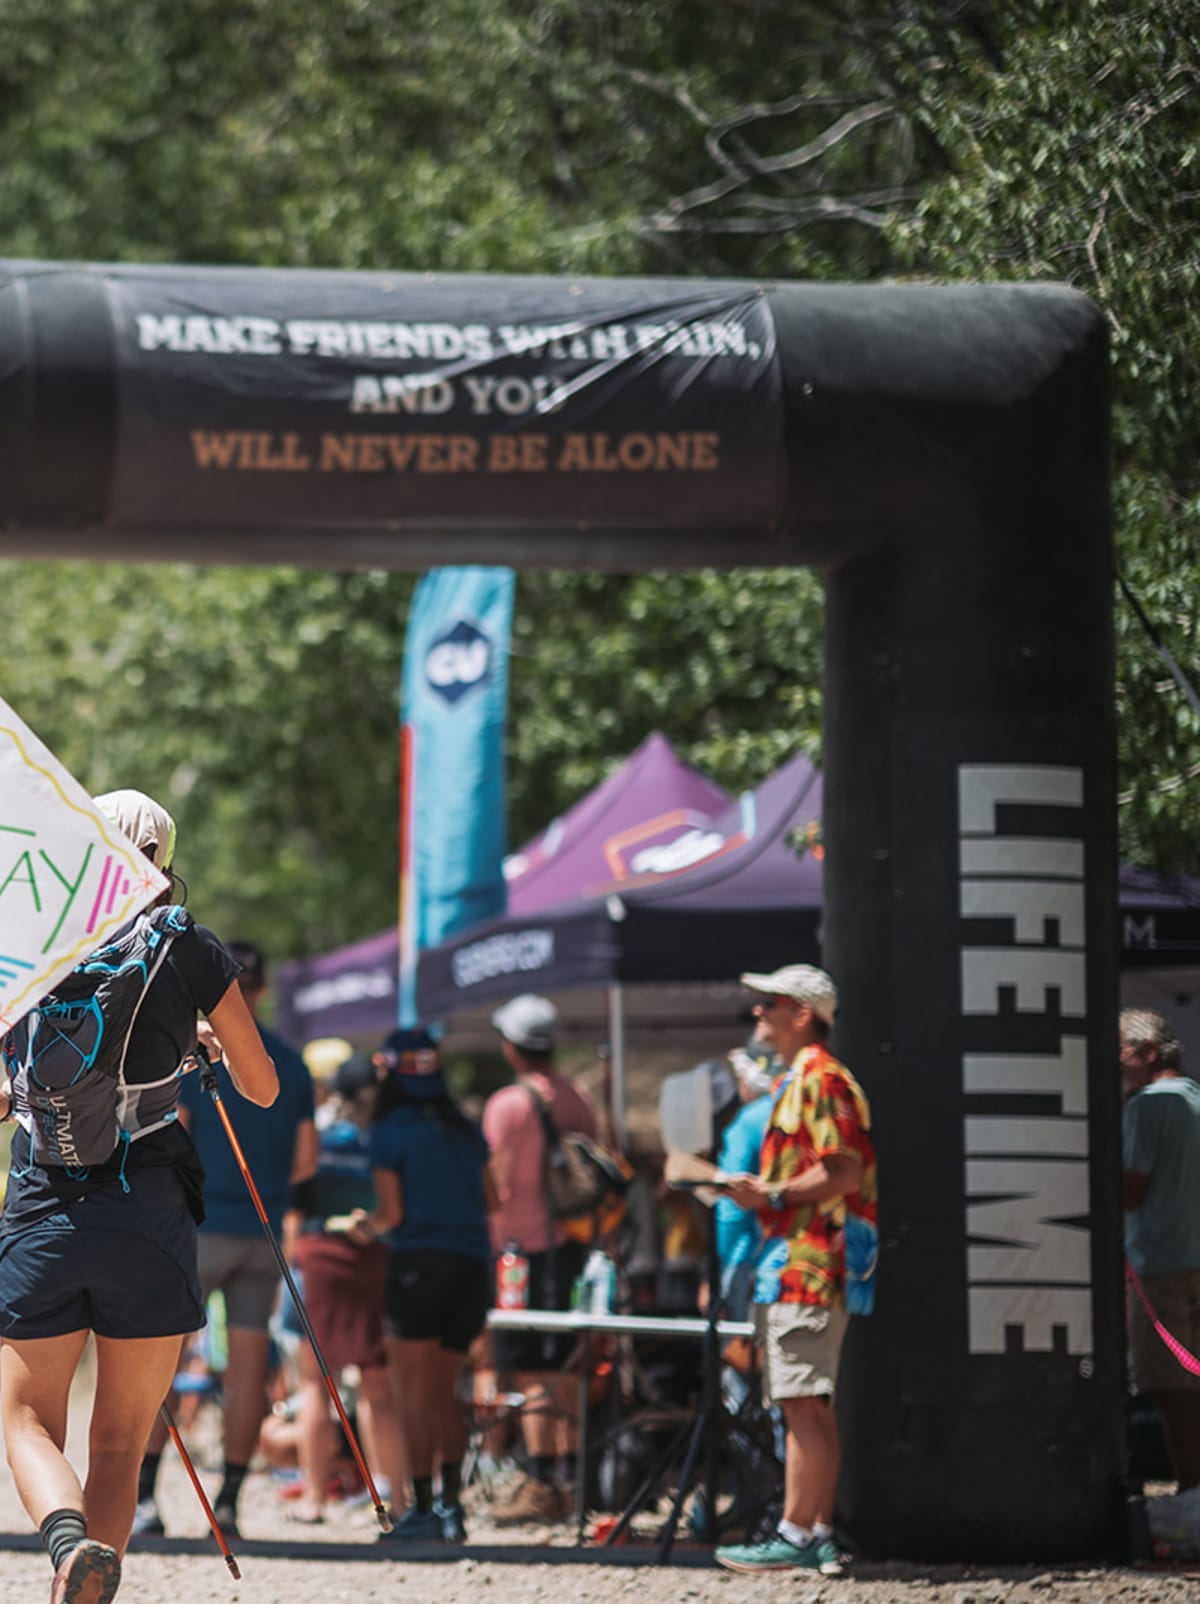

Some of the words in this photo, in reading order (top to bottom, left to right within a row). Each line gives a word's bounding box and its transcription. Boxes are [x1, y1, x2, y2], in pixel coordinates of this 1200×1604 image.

[136, 314, 282, 354] MAKE
[285, 318, 494, 361] FRIENDS
[349, 375, 455, 414] AND
[190, 430, 311, 471] WILL
[319, 433, 480, 473] NEVER
[488, 431, 548, 472] BE
[557, 431, 721, 472] ALONE
